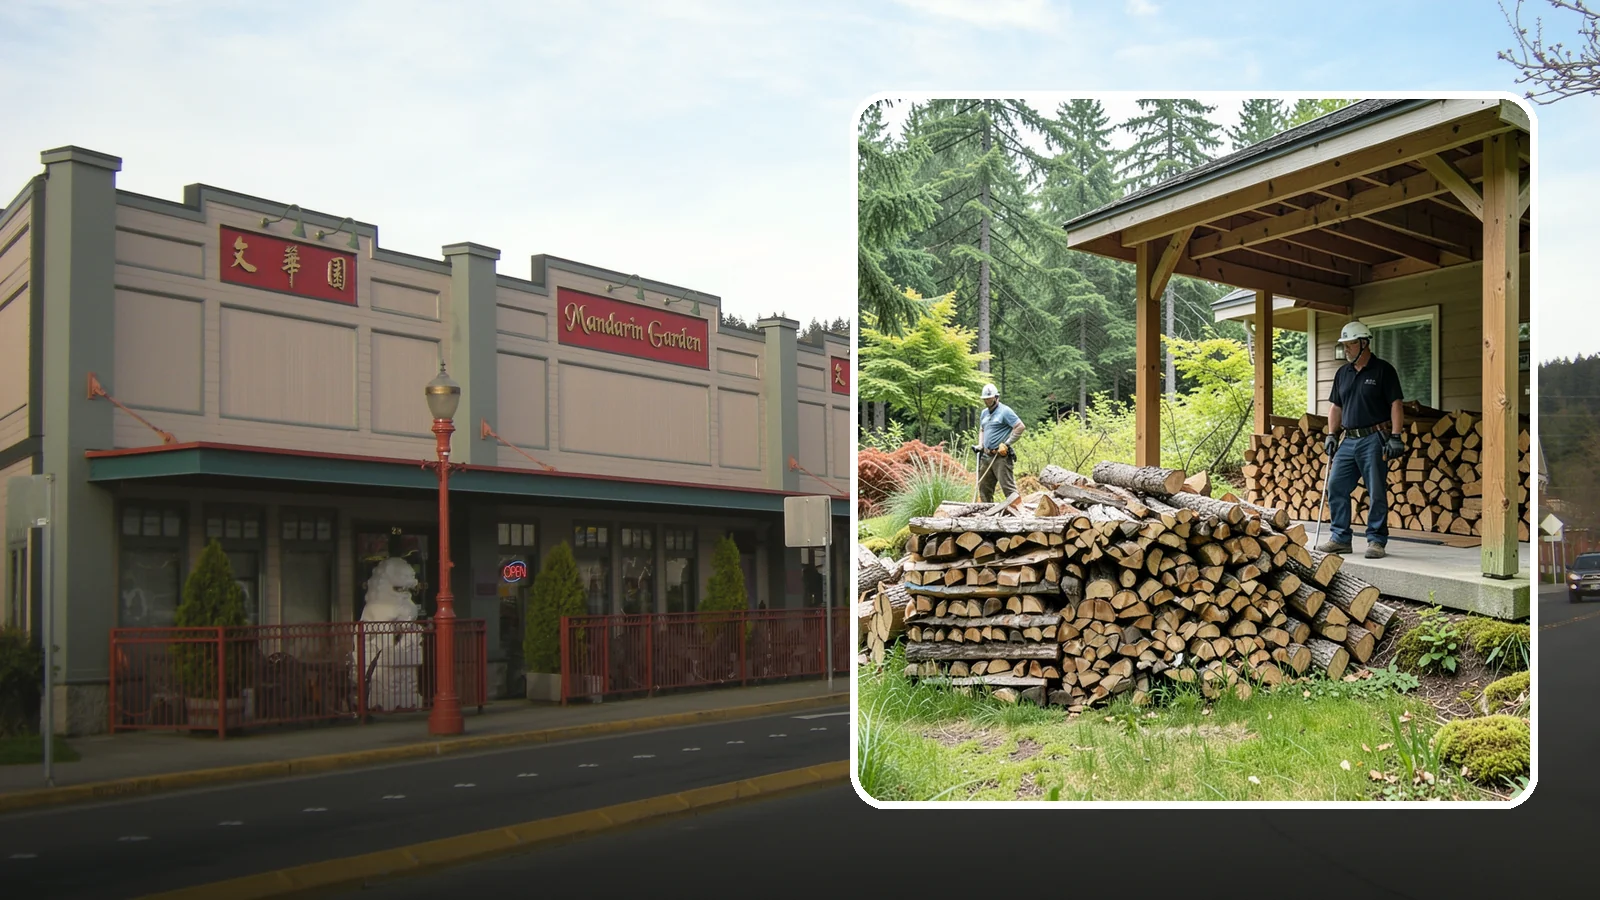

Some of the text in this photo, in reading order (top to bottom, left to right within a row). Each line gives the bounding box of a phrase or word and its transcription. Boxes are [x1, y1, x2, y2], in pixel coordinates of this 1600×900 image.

[231, 236, 346, 291] 文華園
[564, 302, 702, 352] Mandarin Garden
[503, 565, 527, 578] OPEN
